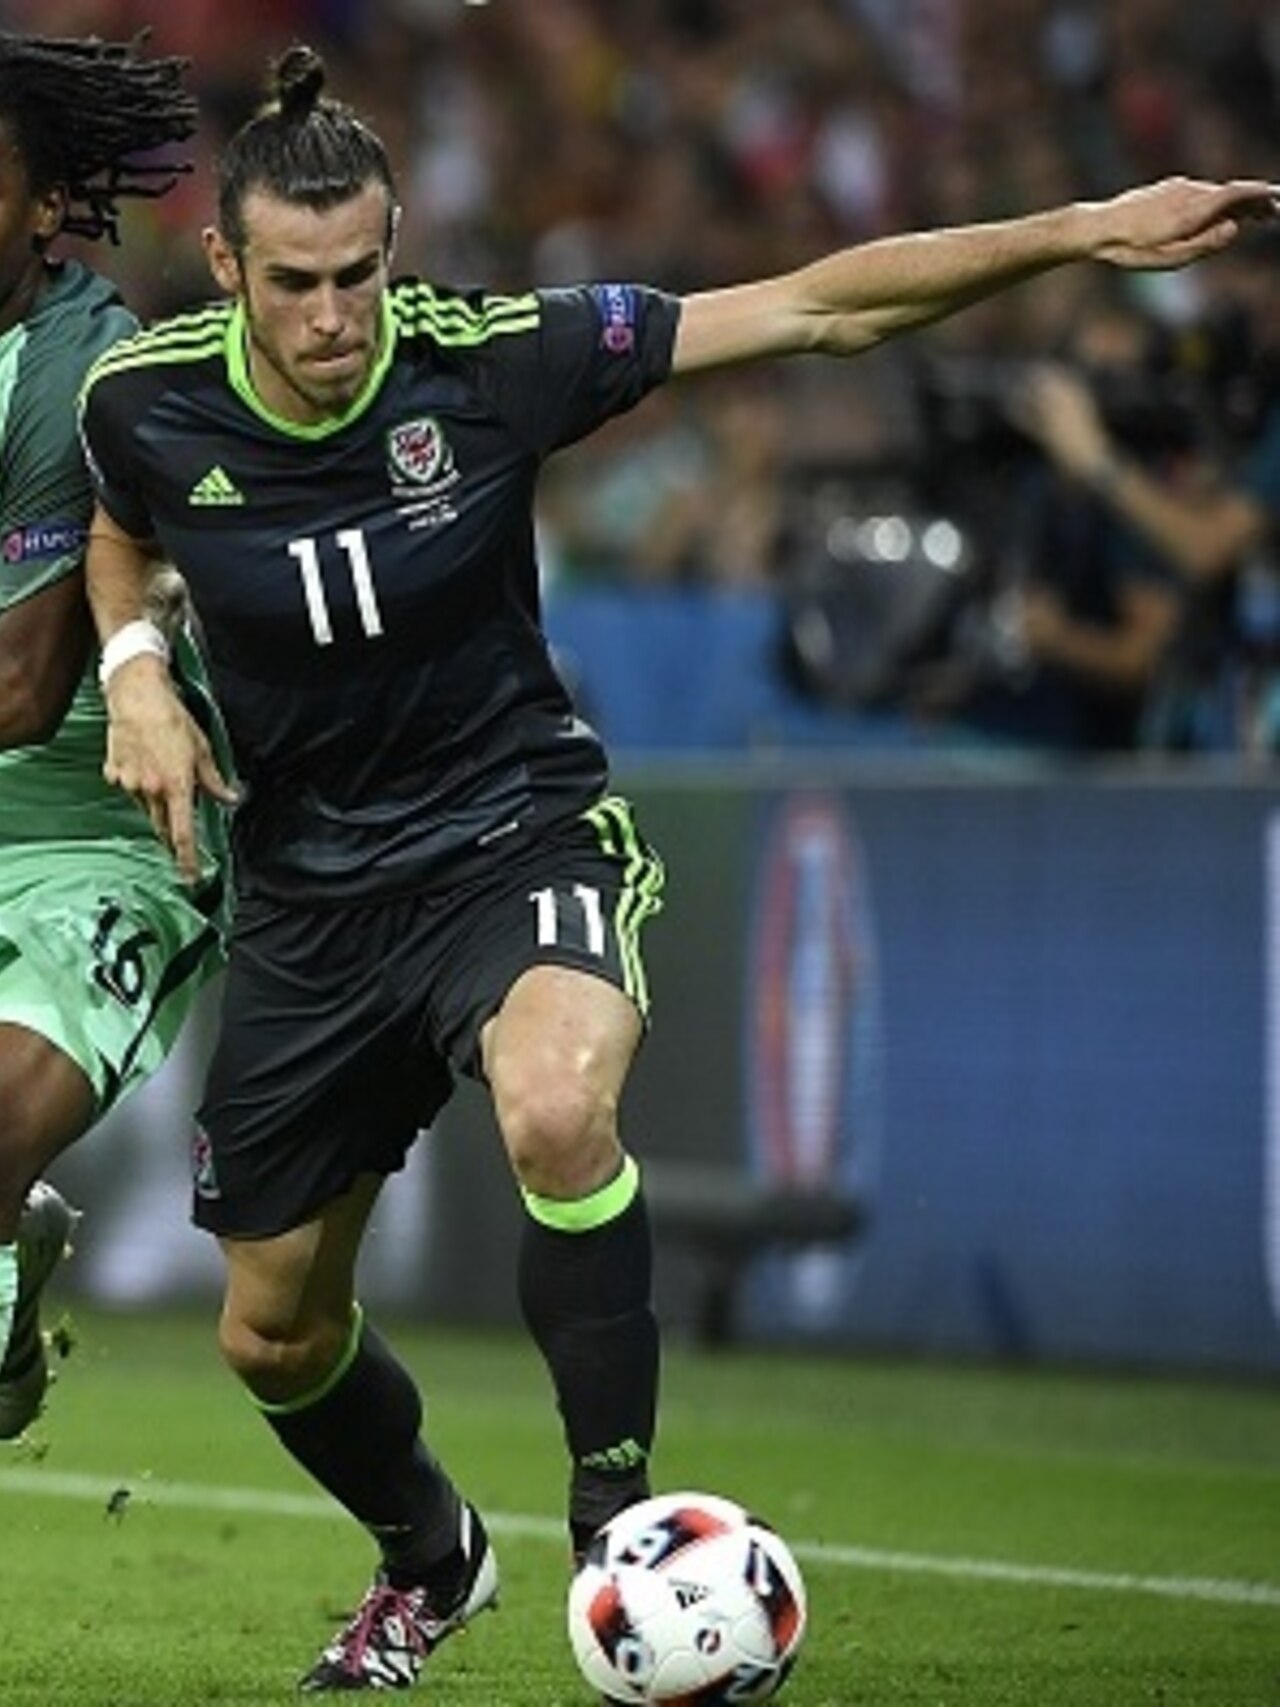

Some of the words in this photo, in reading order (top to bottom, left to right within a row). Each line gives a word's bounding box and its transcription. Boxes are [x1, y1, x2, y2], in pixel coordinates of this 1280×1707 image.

[288, 529, 384, 647] 11
[92, 897, 160, 1008] 16
[528, 883, 605, 957] 11
